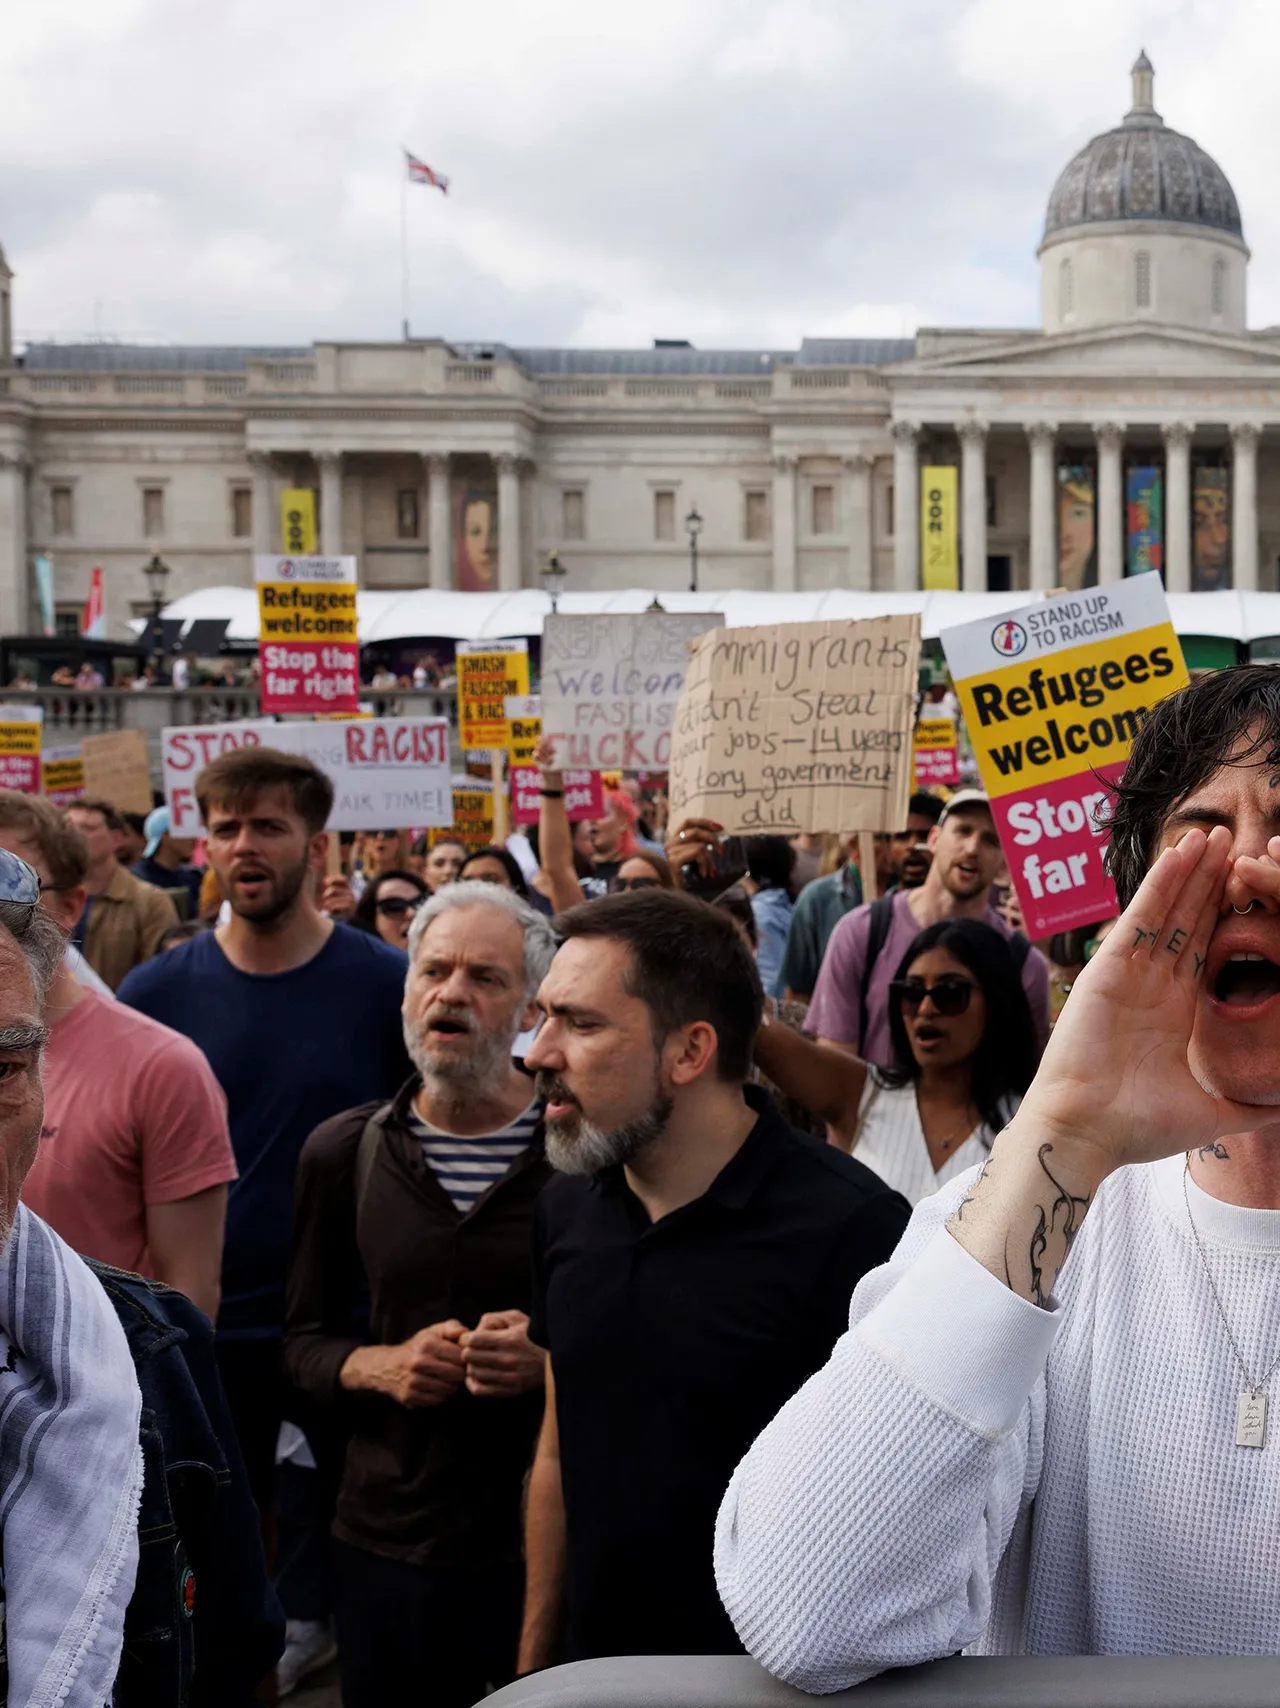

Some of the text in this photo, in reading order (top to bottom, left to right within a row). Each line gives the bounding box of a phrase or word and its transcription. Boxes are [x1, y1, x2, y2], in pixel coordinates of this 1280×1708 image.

[1027, 595, 1109, 632] STAND UP
[1032, 612, 1124, 650] TO RACISM
[264, 645, 355, 672] Stop the
[266, 673, 355, 700] far right
[971, 646, 1175, 727] Refugees
[346, 724, 447, 766] RACIST
[742, 798, 796, 824] did
[1022, 851, 1089, 900] far
